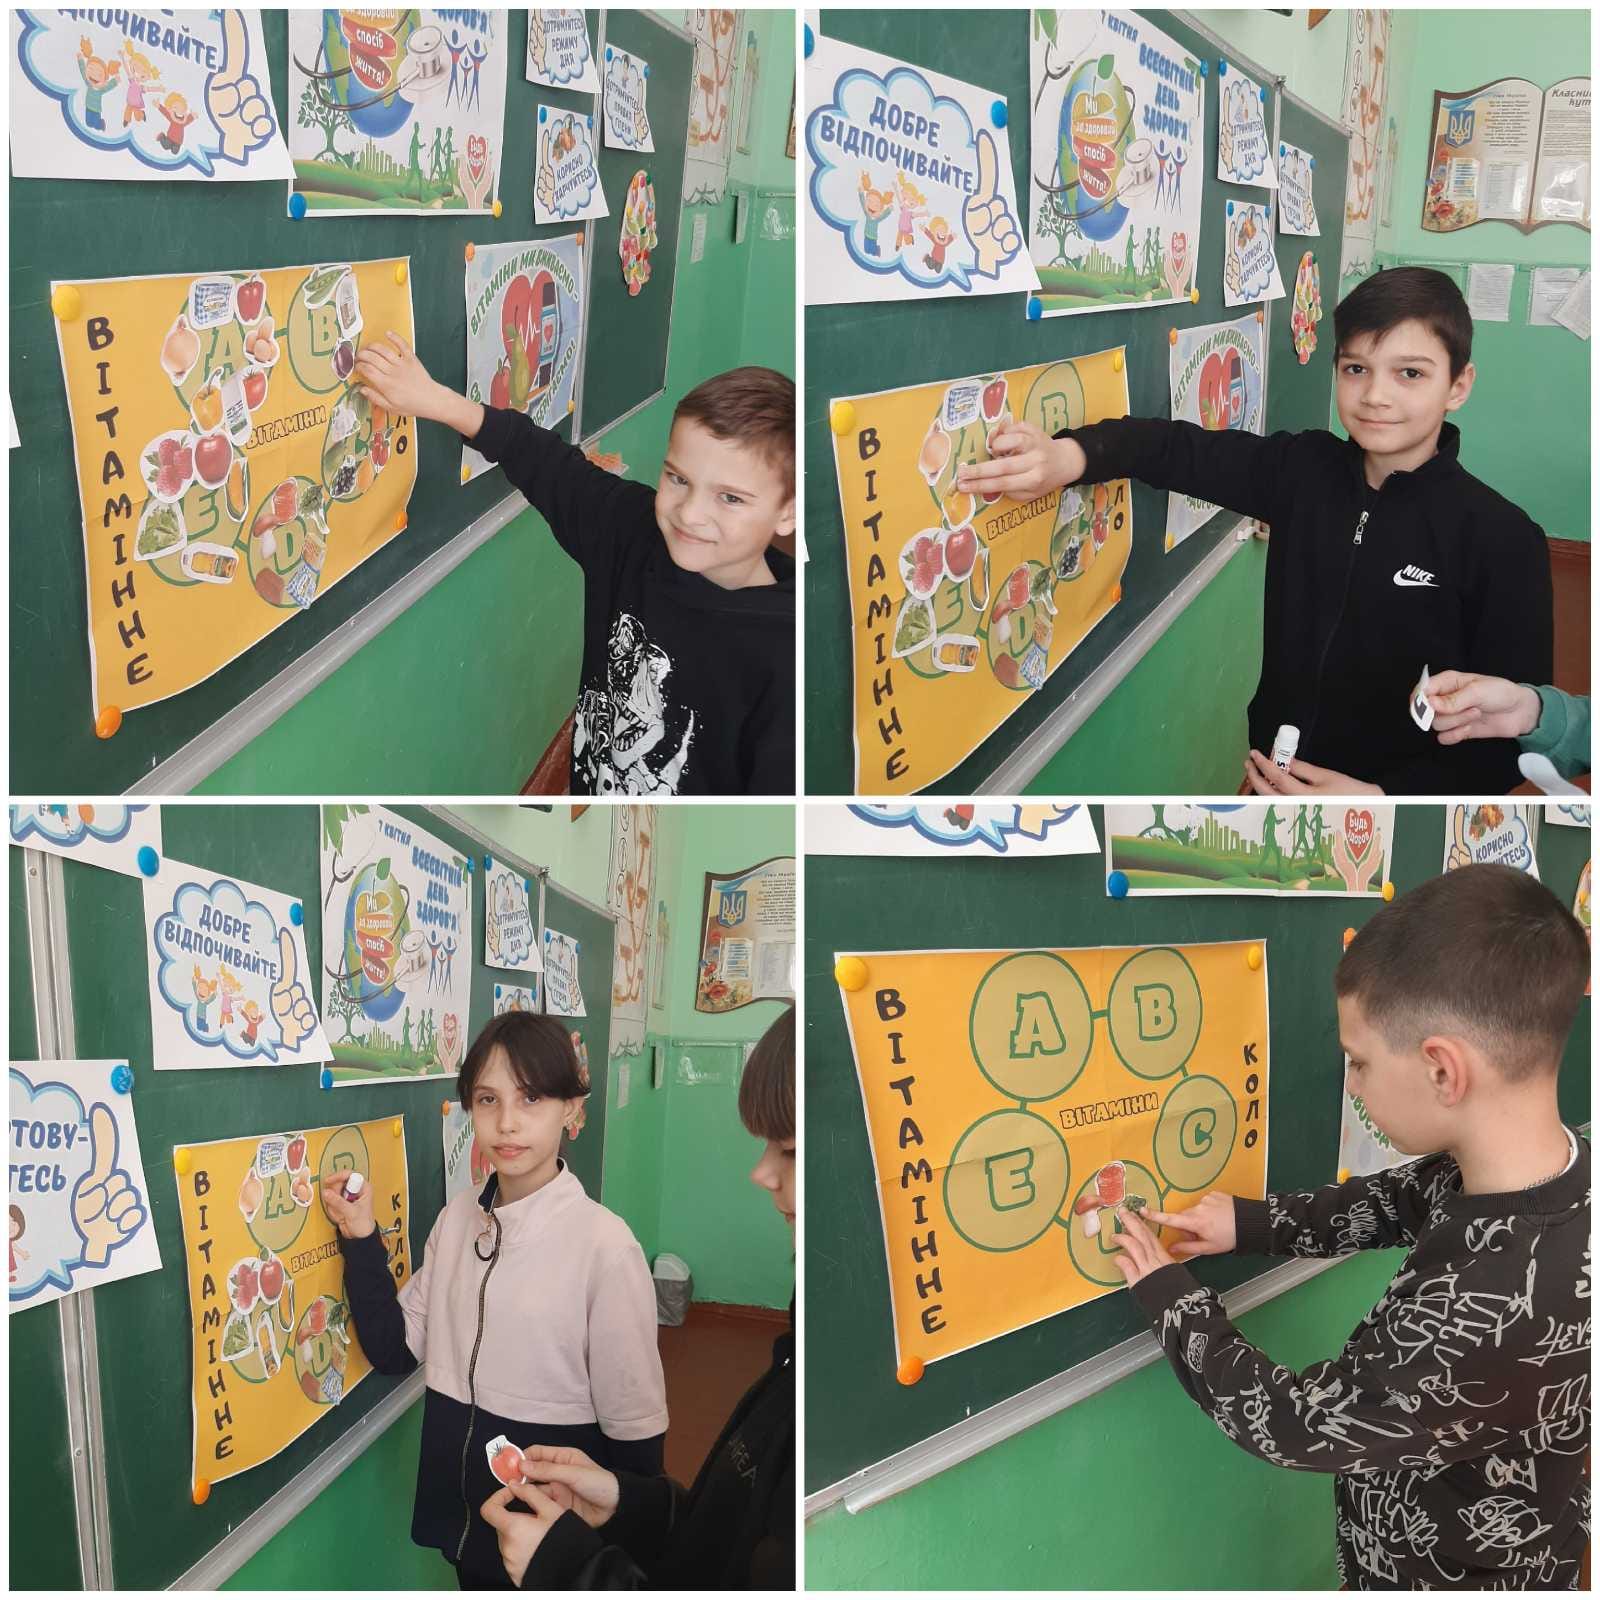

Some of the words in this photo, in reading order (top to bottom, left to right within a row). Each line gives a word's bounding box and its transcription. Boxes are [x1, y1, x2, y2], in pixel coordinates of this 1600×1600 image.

[356, 28, 384, 49] спосіб
[552, 36, 578, 52] РЕЖИМУ
[1107, 15, 1139, 43] КВІТНЯ
[355, 55, 386, 86] життя!
[560, 53, 575, 70] ДНЯ
[1139, 42, 1194, 94] ВСЕСВІТНІЙ
[1085, 96, 1098, 115] Ми
[1155, 82, 1180, 111] ДЕНЬ
[869, 96, 940, 148] ДОБРЕ
[1143, 104, 1188, 142] ЗДОРОВ'Я
[557, 153, 584, 182] КОРИСНО
[820, 115, 975, 193] ВІДПОЧИВАЙТЕ
[1083, 145, 1107, 163] спосіб
[470, 256, 518, 336] ВІТАМІНИ
[246, 405, 326, 449] ВІТАМІНИ
[87, 317, 153, 685] ВІТАМІННЕ
[986, 492, 1057, 541] ВІТАМІНИ
[1403, 564, 1435, 583] NIKE
[858, 427, 909, 781] ВІТАМІННЕ
[384, 823, 412, 848] КВІТНЯ
[1475, 830, 1514, 862] КОРИСНО
[411, 846, 463, 889] ВСЕСВІТНІЙ
[366, 895, 378, 912] Ми
[427, 879, 450, 906] ДЕНЬ
[199, 904, 252, 945] ДОБРЕ
[416, 900, 458, 932] ЗДОРОВ'Я
[164, 920, 278, 982] ВІДПОЧИВАЙТЕ
[1059, 1091, 1159, 1130] ВІТАМІНИ
[1243, 1043, 1260, 1148] КОЛО
[9, 1119, 88, 1150] ТОВУ-
[875, 989, 947, 1334] ВІТАМІННЕ
[290, 1239, 339, 1274] ВІТАМІН
[193, 1170, 235, 1460] ВІТАМІННЕ
